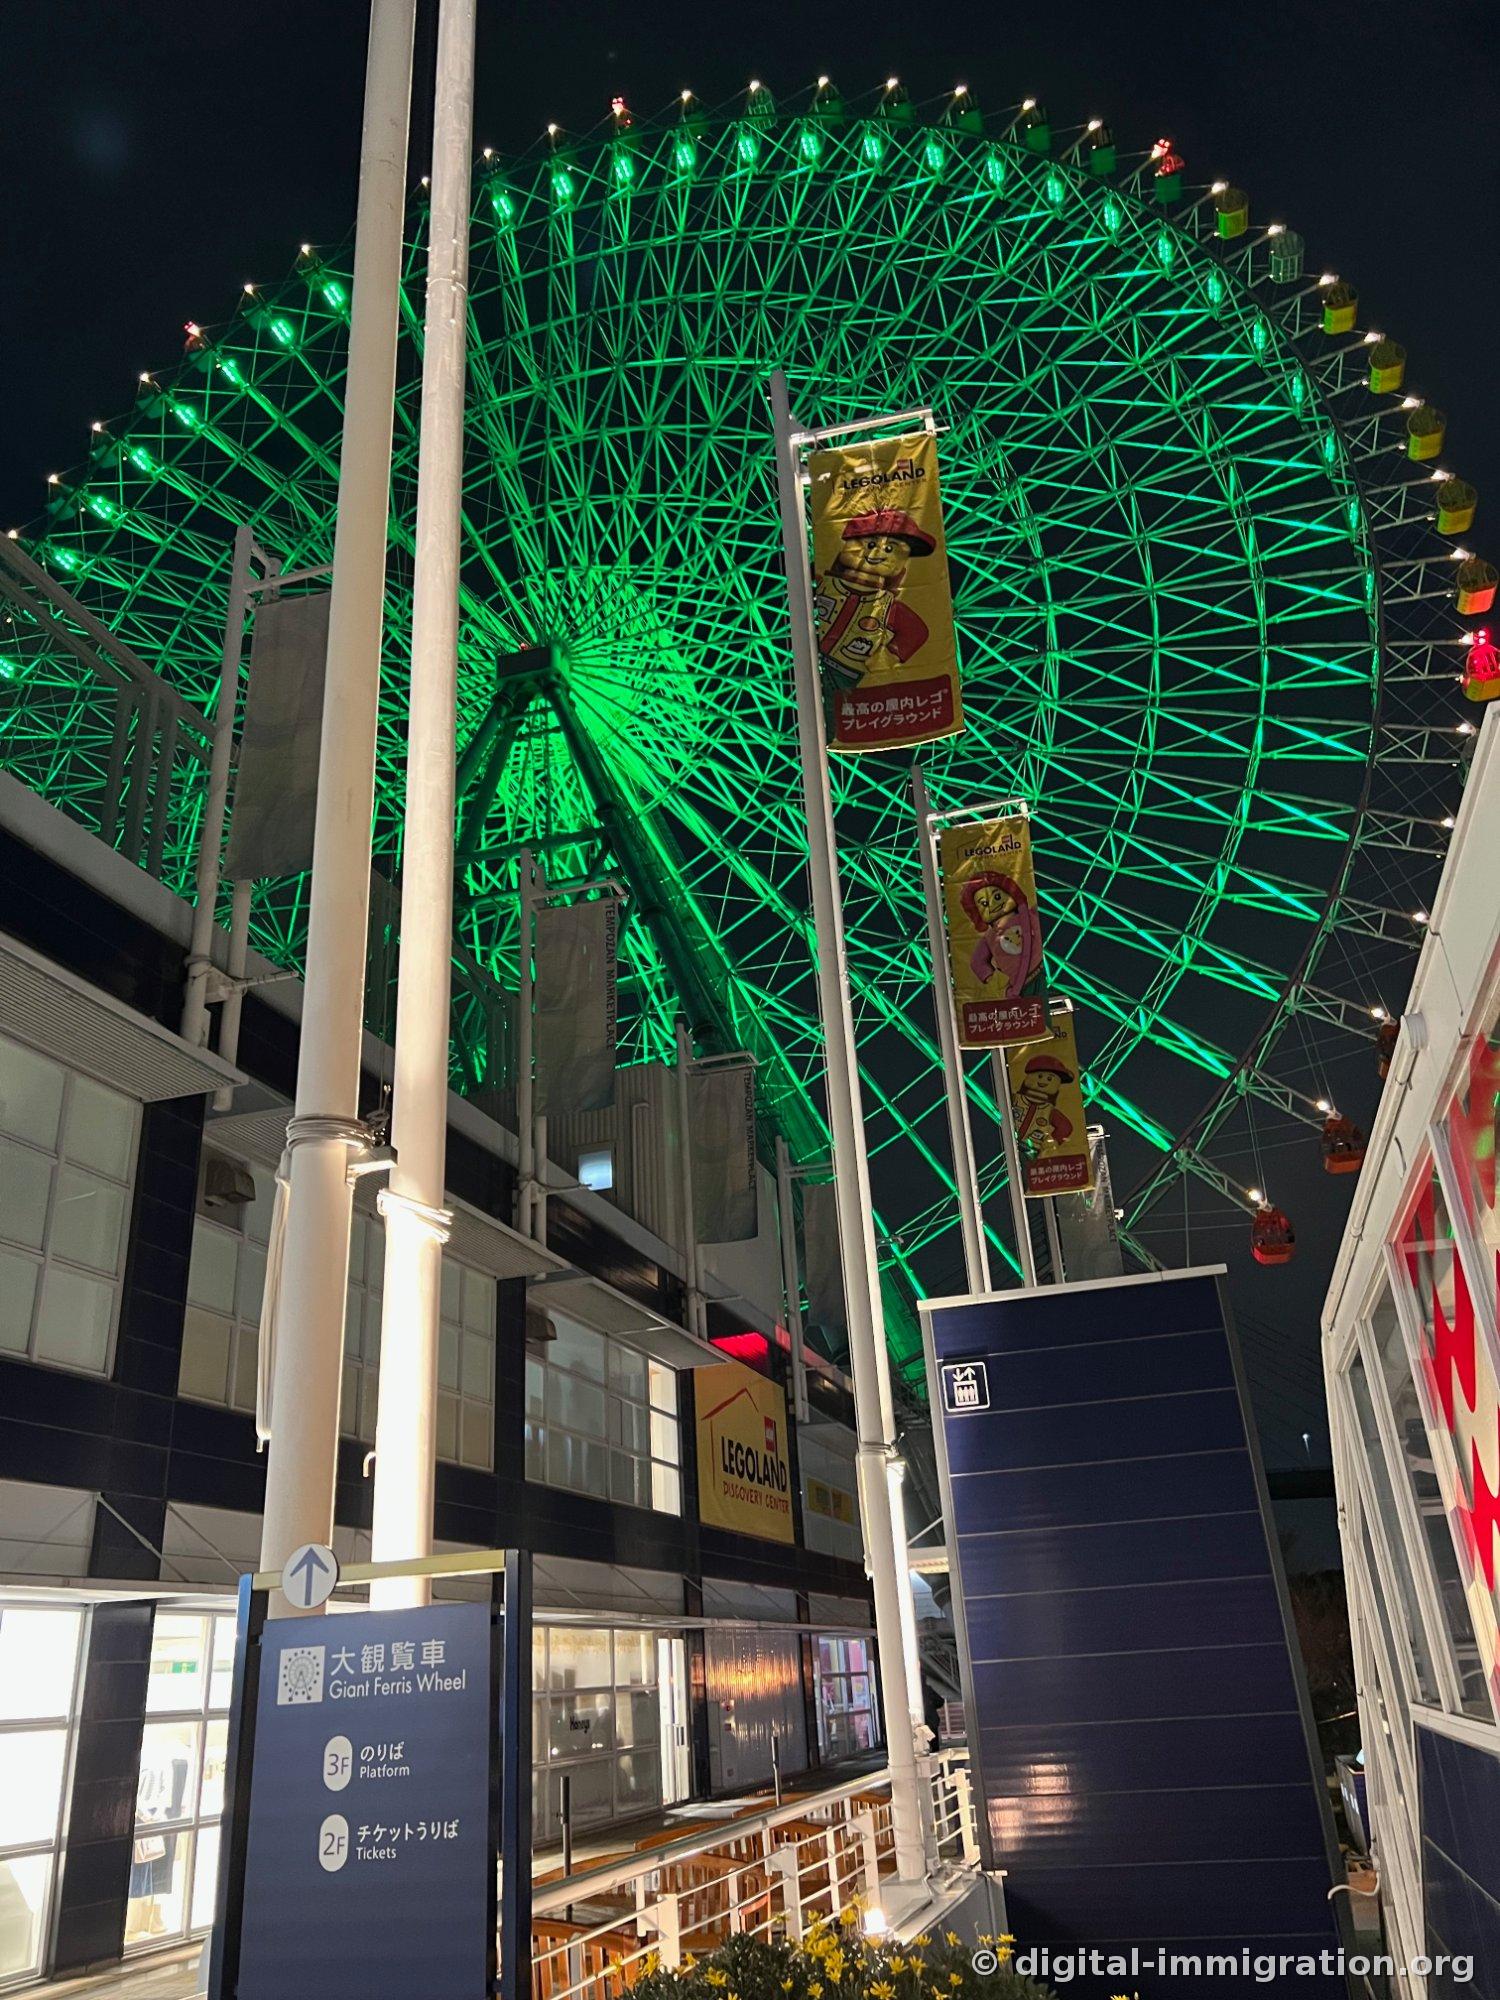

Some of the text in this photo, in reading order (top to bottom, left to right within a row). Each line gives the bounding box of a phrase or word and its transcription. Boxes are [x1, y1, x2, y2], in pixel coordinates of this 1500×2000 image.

[843, 459, 926, 490] LEGOLAND
[964, 834, 1022, 857] LEGOLAND
[604, 902, 617, 1051] TEMPOZAN MARKETPLACE
[721, 1420, 788, 1493] LEGOLAND
[722, 1480, 790, 1514] DISCOVERY CENTER
[330, 1638, 446, 1676] 大観覧車
[328, 1668, 466, 1699] Giant Ferris Wheel
[360, 1741, 405, 1762] のりば
[327, 1753, 350, 1776] 3F
[359, 1763, 410, 1779] Platform
[357, 1819, 460, 1843] チケットうりば
[323, 1832, 346, 1856] 2F
[355, 1845, 397, 1861] Tickets
